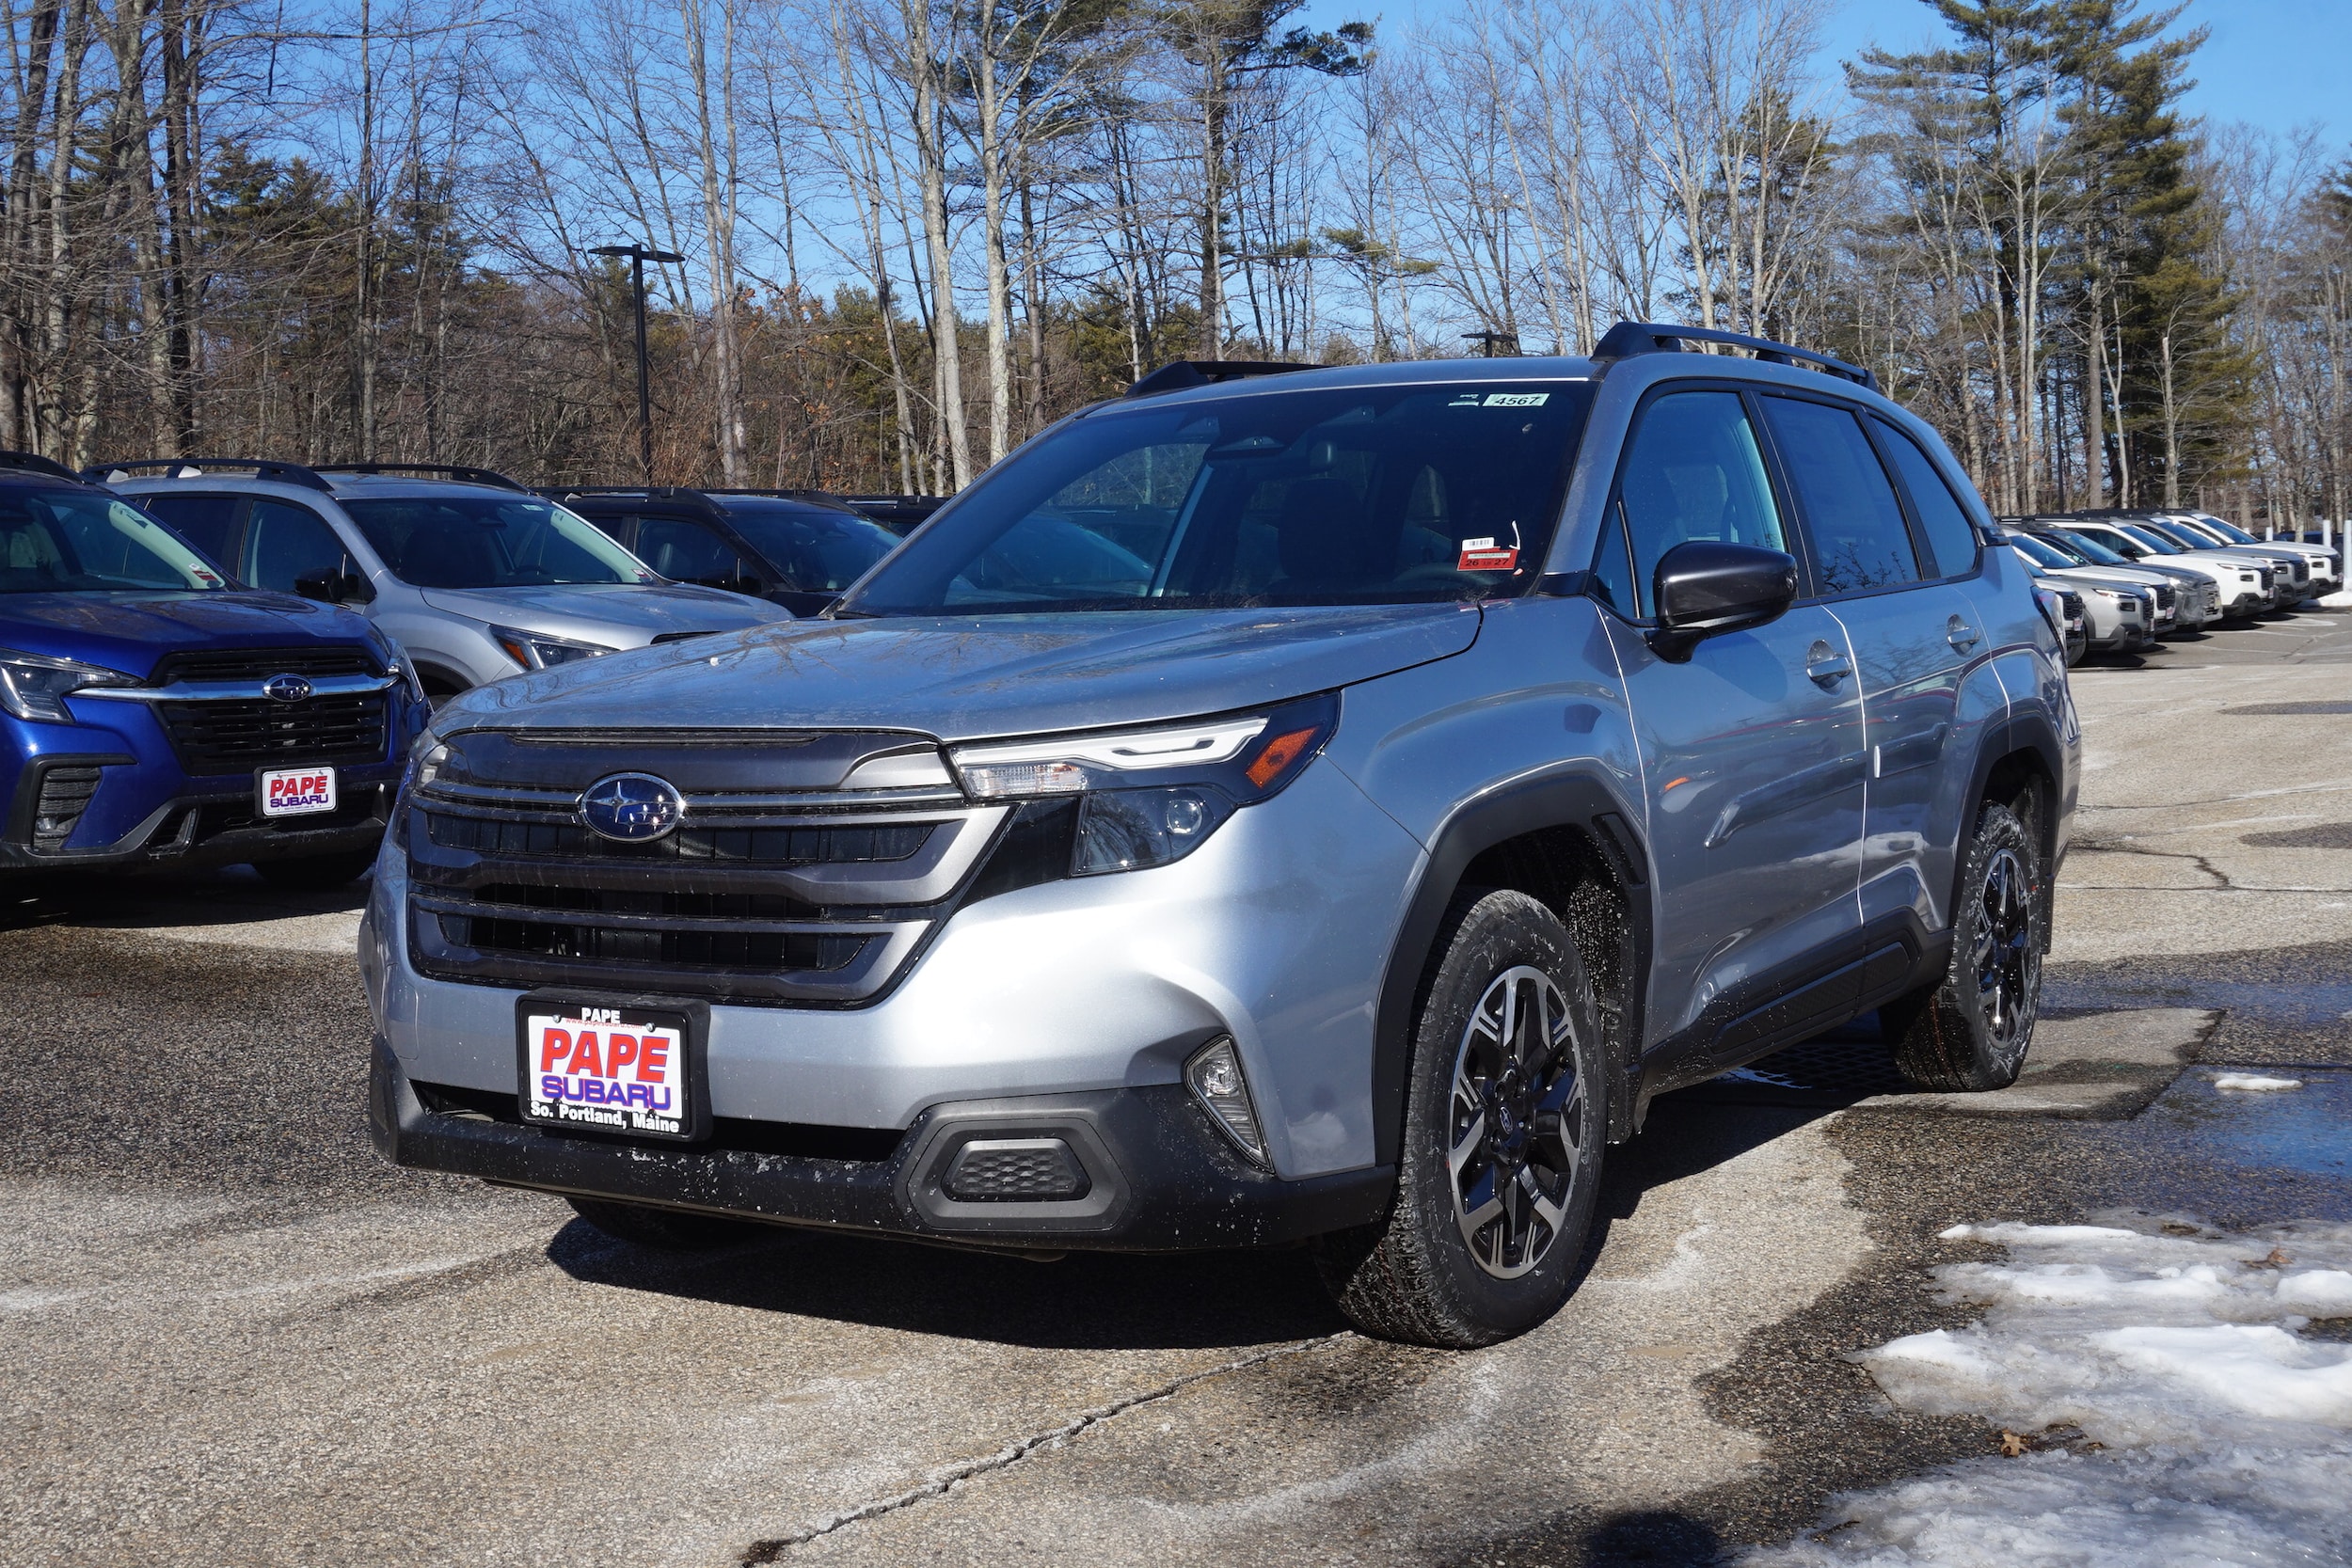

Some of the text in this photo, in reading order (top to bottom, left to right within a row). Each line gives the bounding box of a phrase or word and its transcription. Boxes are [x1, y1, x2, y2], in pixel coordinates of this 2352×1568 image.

[1494, 396, 1541, 405] 4567
[269, 775, 328, 799] PAPE
[269, 793, 329, 808] SUBARU
[580, 1006, 621, 1023] PAPE
[540, 1027, 671, 1084] PAPE
[540, 1074, 672, 1111] SUBARU
[530, 1101, 680, 1133] So. Portland, Maine
